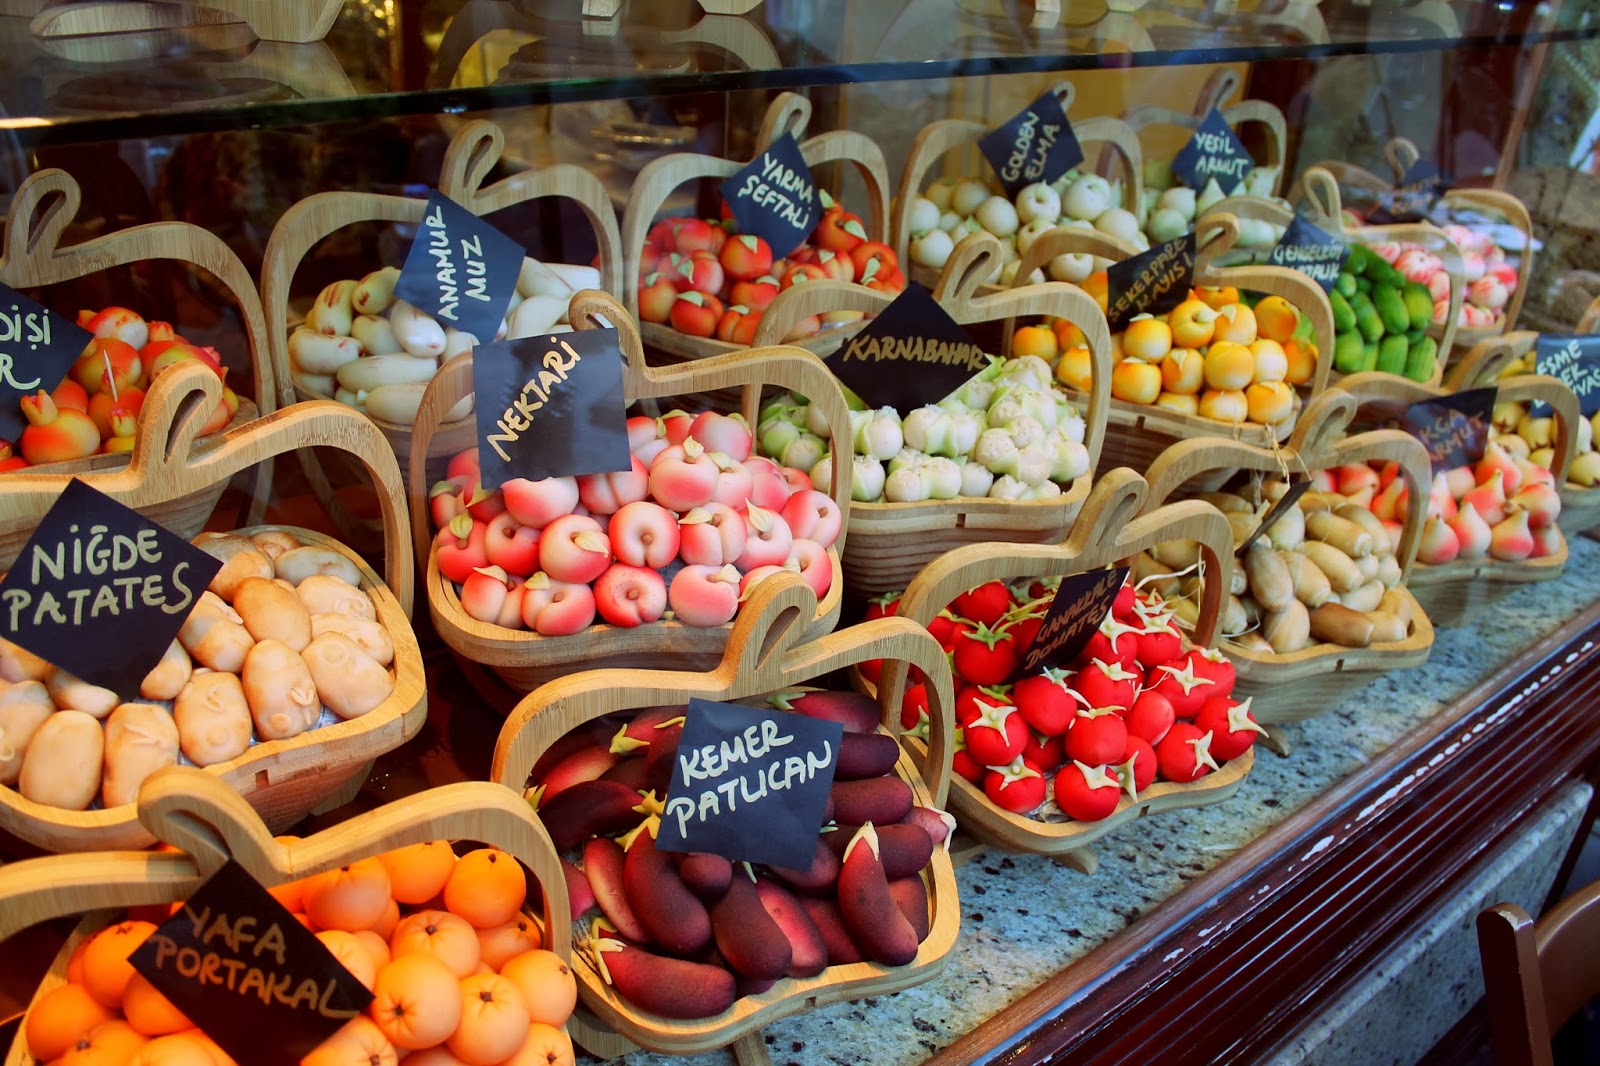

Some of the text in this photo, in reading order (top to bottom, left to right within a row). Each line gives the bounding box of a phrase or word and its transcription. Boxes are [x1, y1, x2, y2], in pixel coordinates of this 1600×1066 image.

[762, 152, 813, 204] YARMA
[1001, 111, 1040, 182] GOLDEN
[1024, 124, 1060, 179] ELMA
[425, 204, 460, 322] ANAMUR
[461, 234, 492, 302] MUZ
[843, 334, 987, 371] KARNABAHAR
[2, 561, 193, 632] PATATES
[680, 719, 795, 788] KEMER
[666, 739, 832, 839] PATLICAN
[184, 906, 287, 966] YAFA
[148, 934, 361, 1019] PORTAKAL
